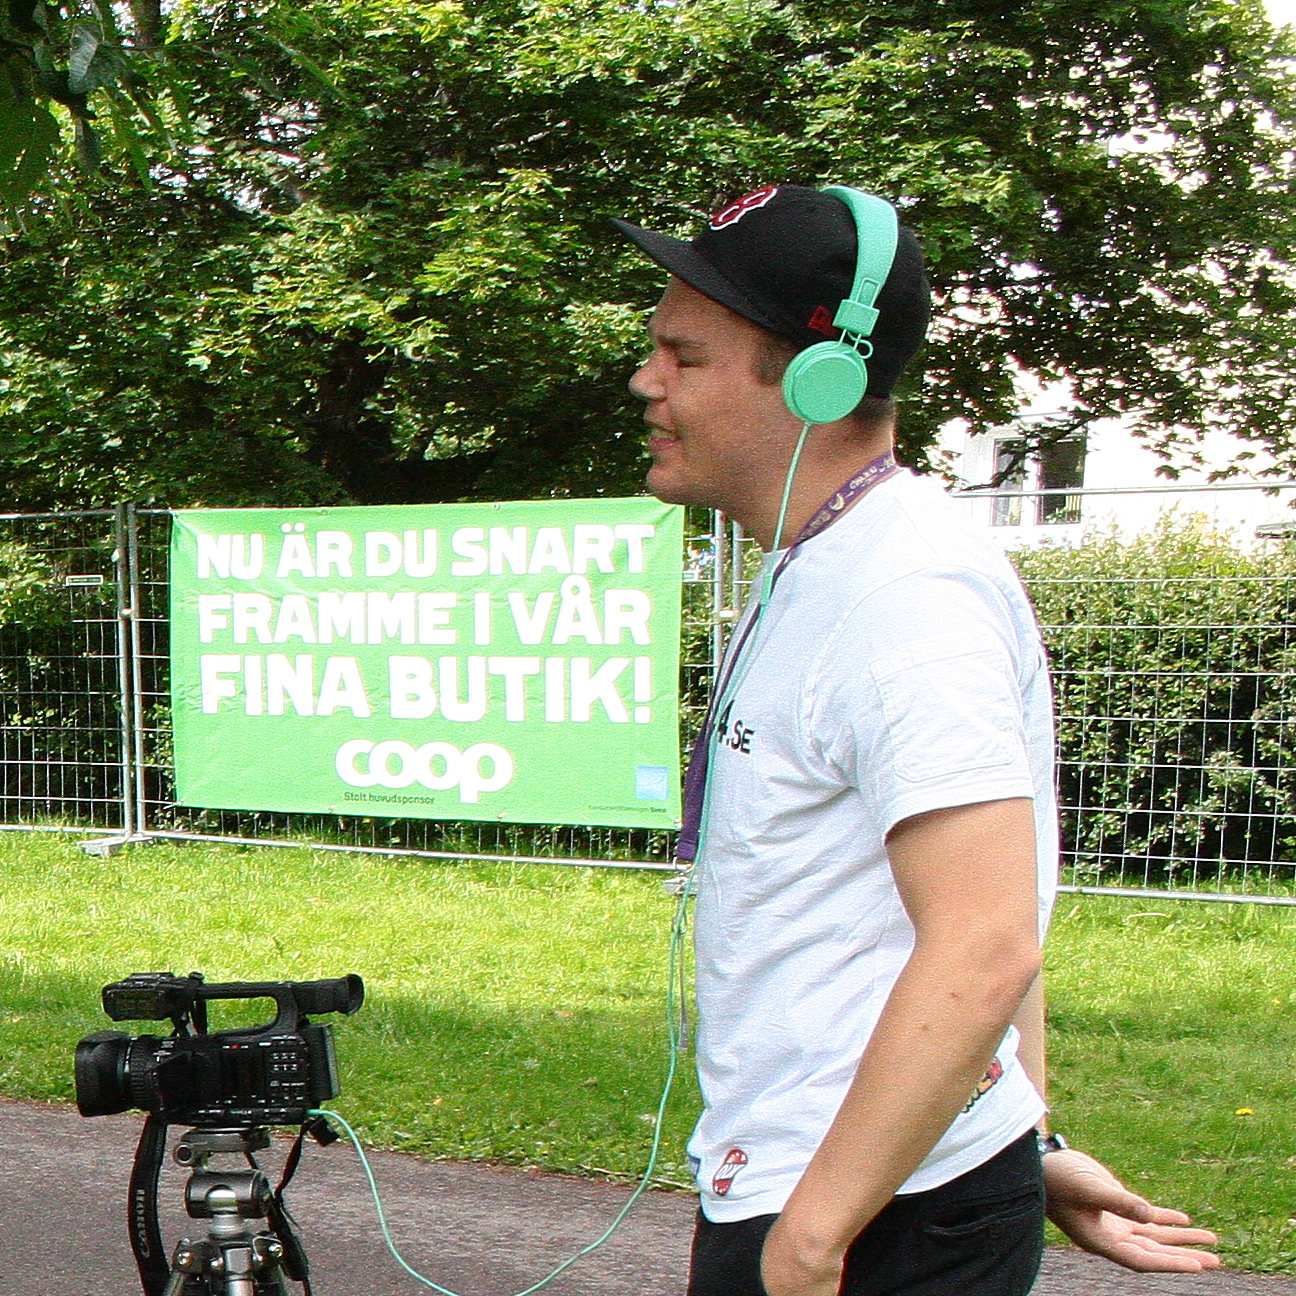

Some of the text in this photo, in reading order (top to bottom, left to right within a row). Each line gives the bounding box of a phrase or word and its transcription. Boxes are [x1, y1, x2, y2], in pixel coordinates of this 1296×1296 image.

[197, 522, 656, 580] NU ÄR DU SNART
[198, 574, 652, 646] FRAMME I VÅR
[201, 653, 652, 724] FINA BUTIK!
[335, 738, 514, 804] coop
